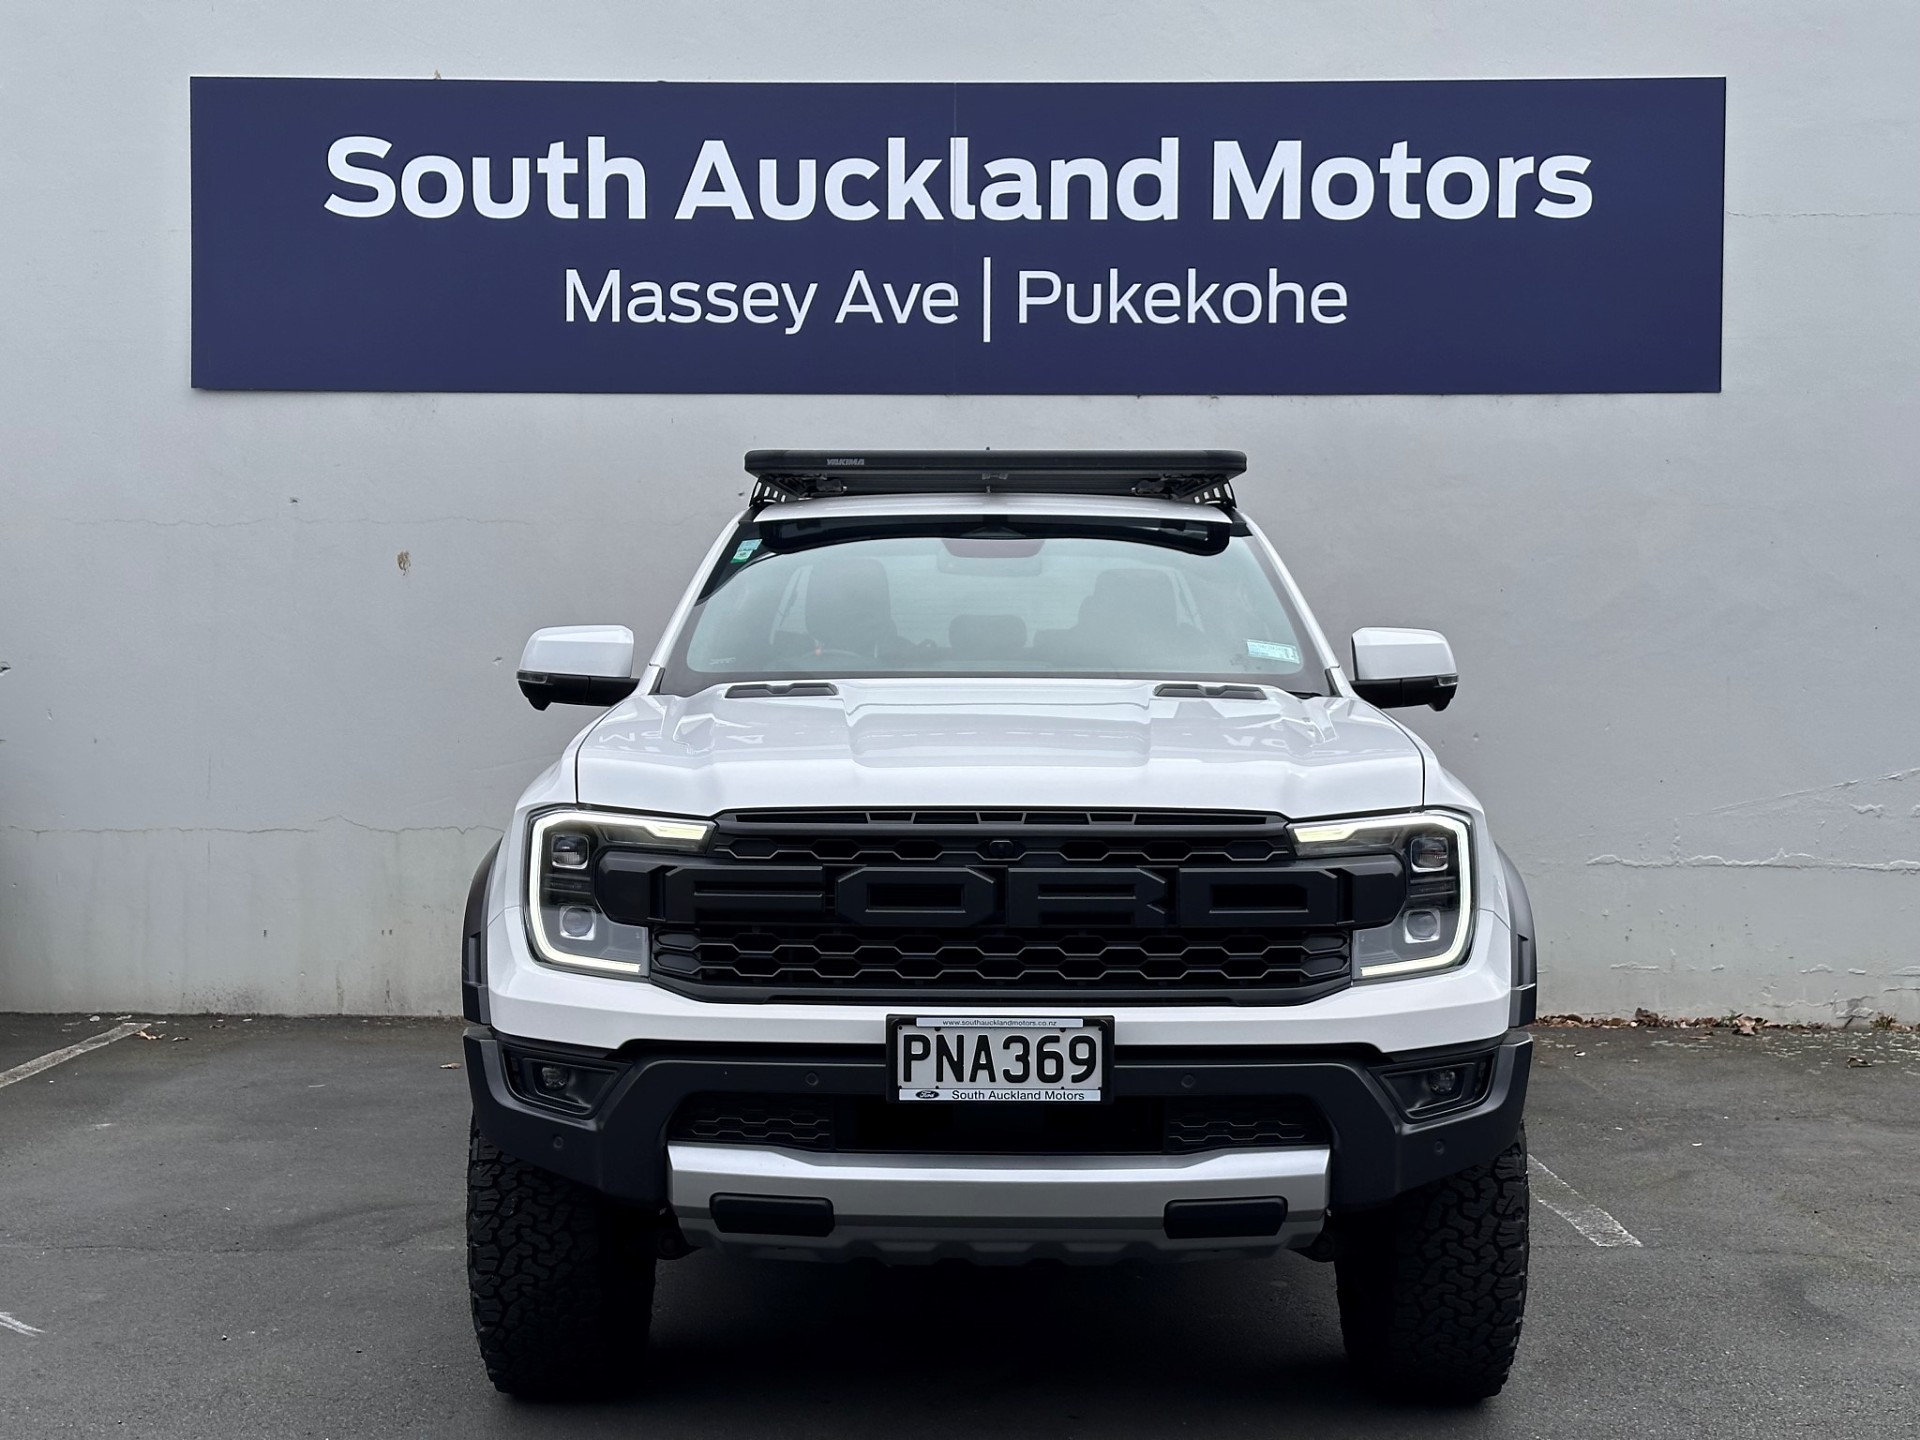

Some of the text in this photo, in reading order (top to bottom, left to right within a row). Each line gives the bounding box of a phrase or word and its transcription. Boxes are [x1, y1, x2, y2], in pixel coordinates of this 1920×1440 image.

[324, 136, 1593, 222] South Auckland Motors
[565, 267, 1349, 335] Massey Ave Pukekohe
[826, 458, 865, 466] YAKIMA
[664, 864, 1340, 928] FORD
[941, 1018, 1057, 1027] www.southaucklandmotors.co.nz
[903, 1034, 1097, 1084] PNA369
[951, 1090, 1085, 1101] South Auckland Motors
